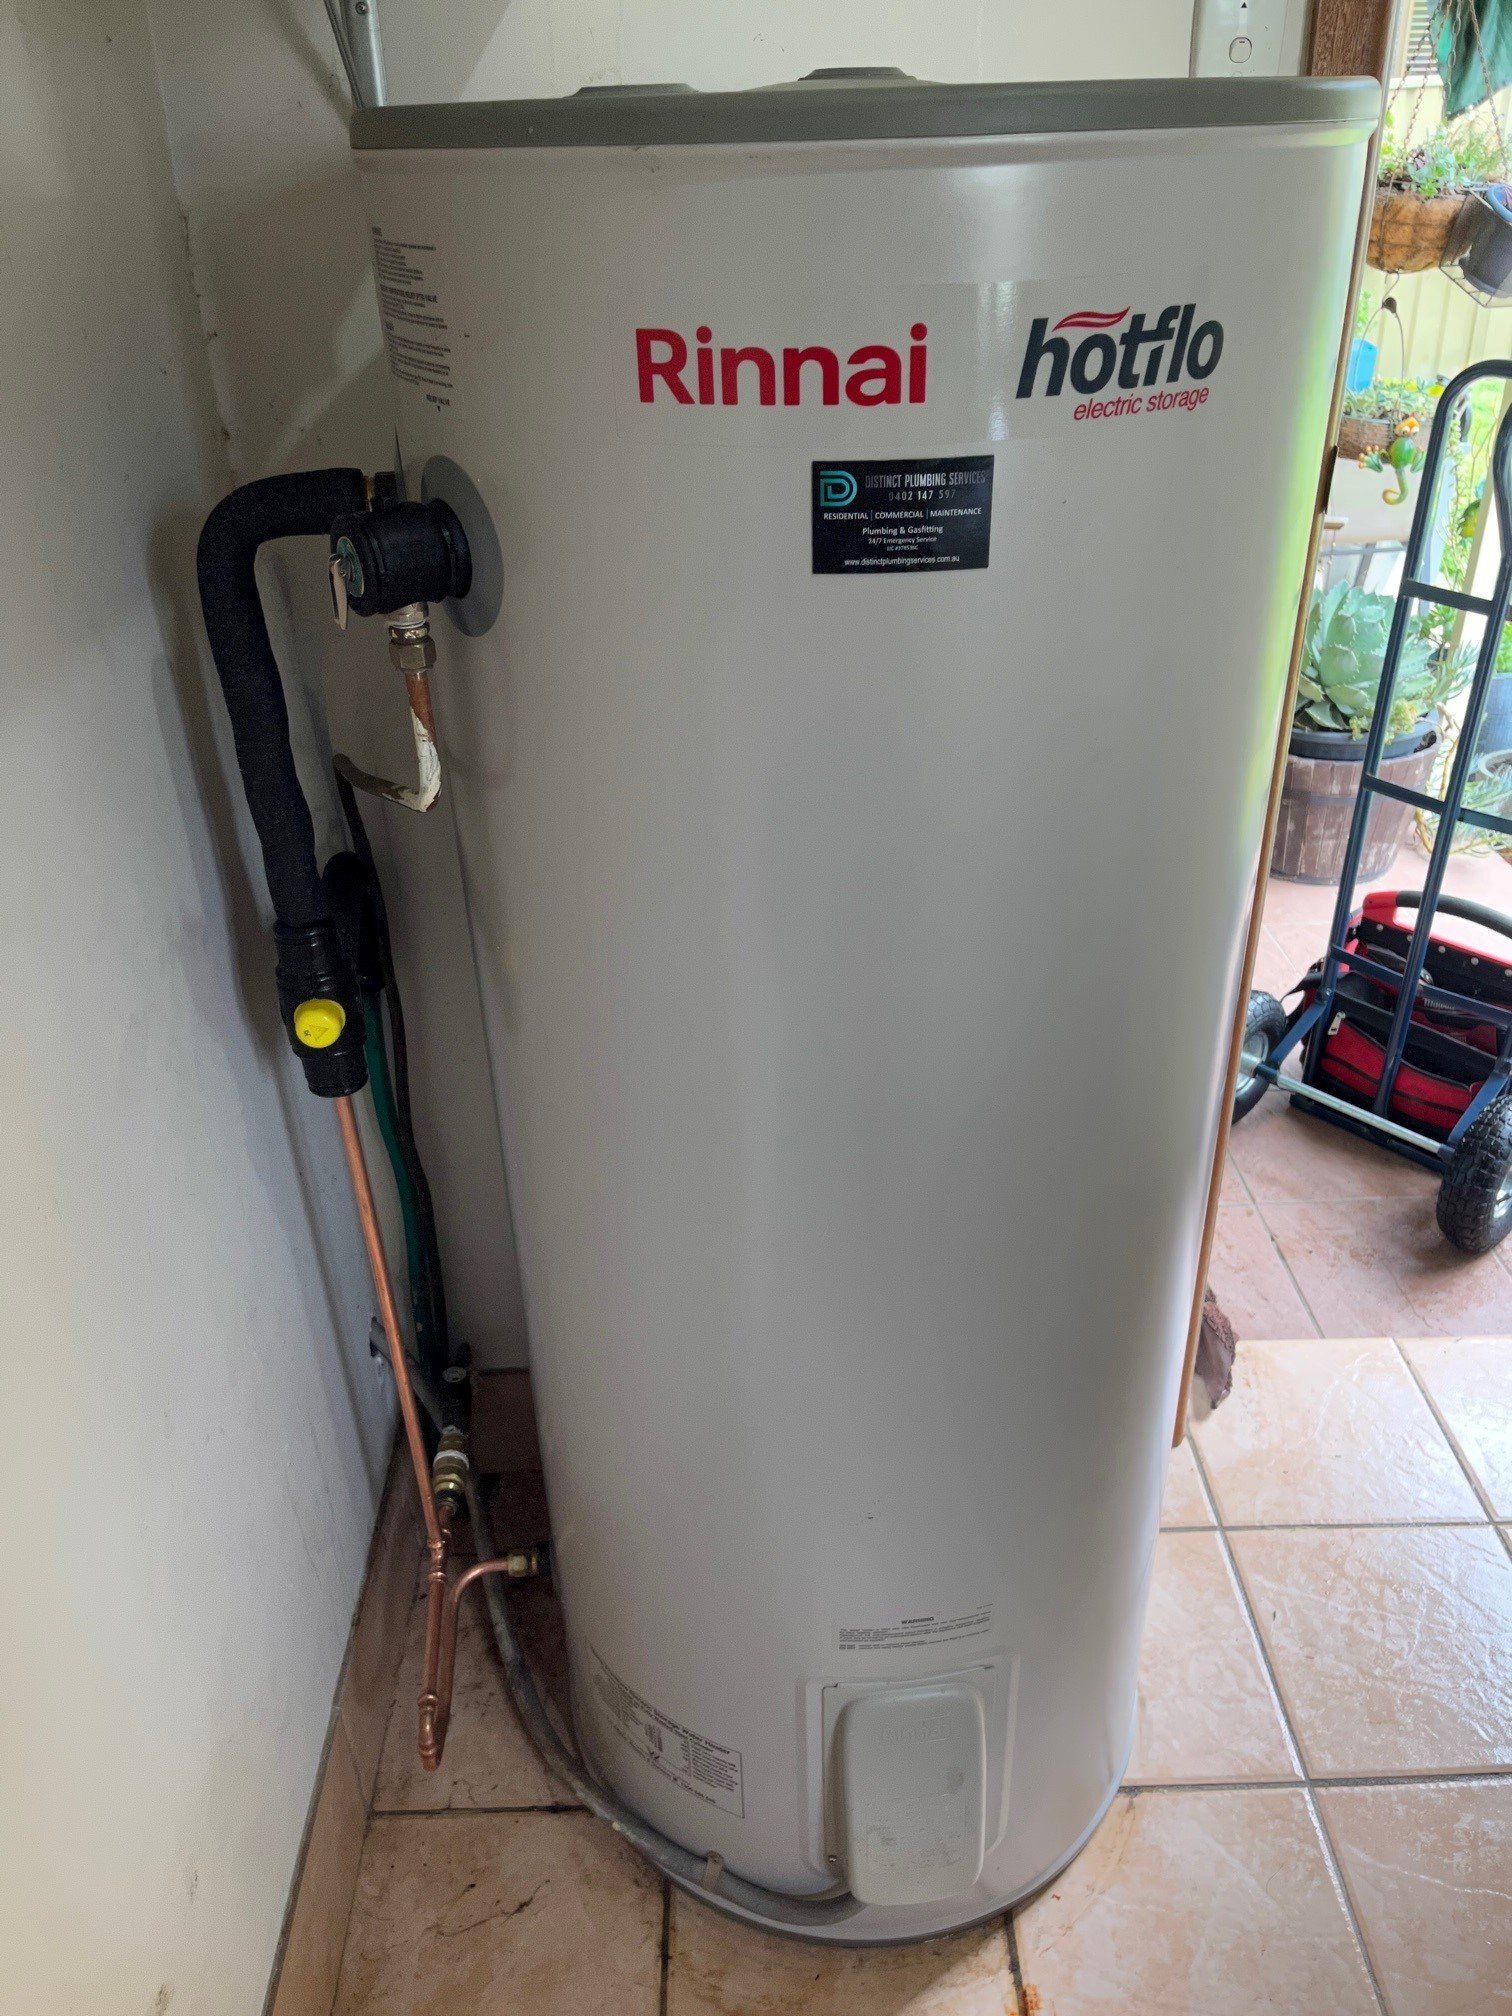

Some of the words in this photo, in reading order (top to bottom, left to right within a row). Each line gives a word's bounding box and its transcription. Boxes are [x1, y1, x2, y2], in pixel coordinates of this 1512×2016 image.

[1016, 303, 1225, 400] hotflo
[635, 322, 928, 406] Rinnai
[1073, 393, 1143, 420] electric
[1146, 387, 1210, 412] storage
[865, 474, 902, 488] DISTINCT
[904, 472, 946, 487] PLUMBING
[948, 470, 986, 485] SERVICES
[888, 490, 913, 501] 0402
[917, 490, 934, 500] 147
[938, 489, 956, 499] 597
[823, 512, 869, 520] RESIDENTIAL
[874, 511, 924, 519] COMMERCIAL
[929, 507, 982, 517] MAINTENANCE
[862, 527, 898, 536] Plumbing
[907, 525, 944, 534] Gasfitting
[844, 556, 960, 567] www.distinctplumbingservices.com.au
